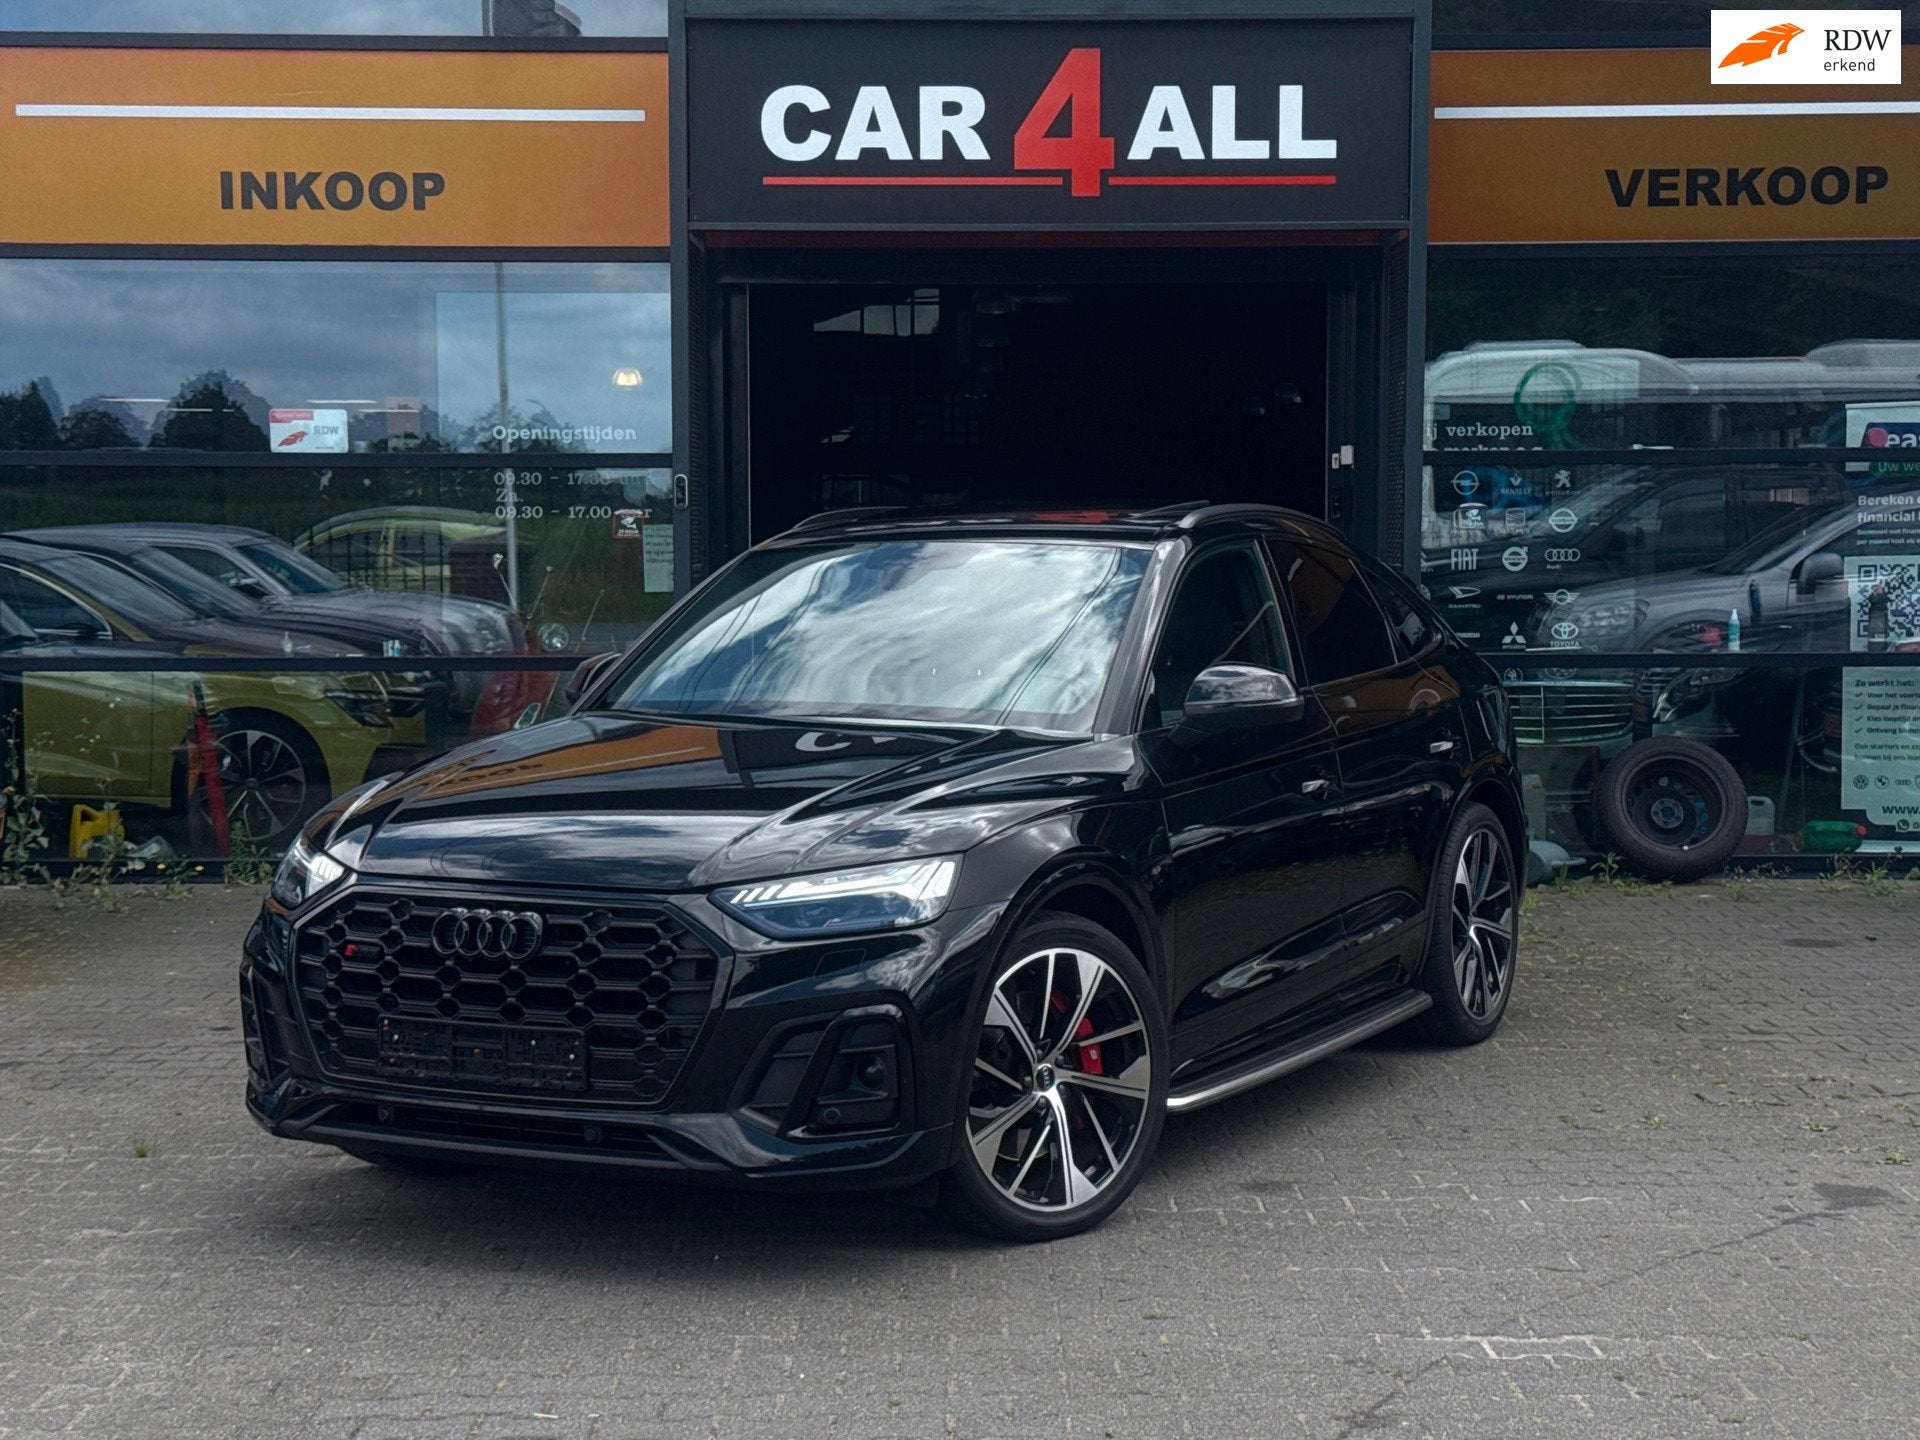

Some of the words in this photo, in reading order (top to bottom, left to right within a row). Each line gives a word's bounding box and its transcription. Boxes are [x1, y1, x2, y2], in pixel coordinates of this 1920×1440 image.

[760, 84, 991, 161] CAR
[1014, 48, 1115, 197] 4
[1127, 84, 1337, 160] ALL
[219, 170, 445, 211] INKOOP
[1605, 164, 1889, 207] VERKOOP
[314, 425, 339, 435] RDW
[492, 425, 637, 444] Openingstijden
[1445, 422, 1534, 440] verkopen
[494, 472, 543, 485] 09.30
[567, 472, 611, 486] 17.30
[496, 488, 524, 503] Za.
[1857, 494, 1914, 507] Bereken
[495, 506, 544, 519] 09.30
[568, 506, 612, 519] 17.00
[1857, 511, 1915, 523] financial
[1450, 548, 1480, 571] FIAT
[1549, 640, 1580, 648] TOYOTA
[1855, 679, 1866, 687] Zo
[1868, 678, 1895, 687] werkt
